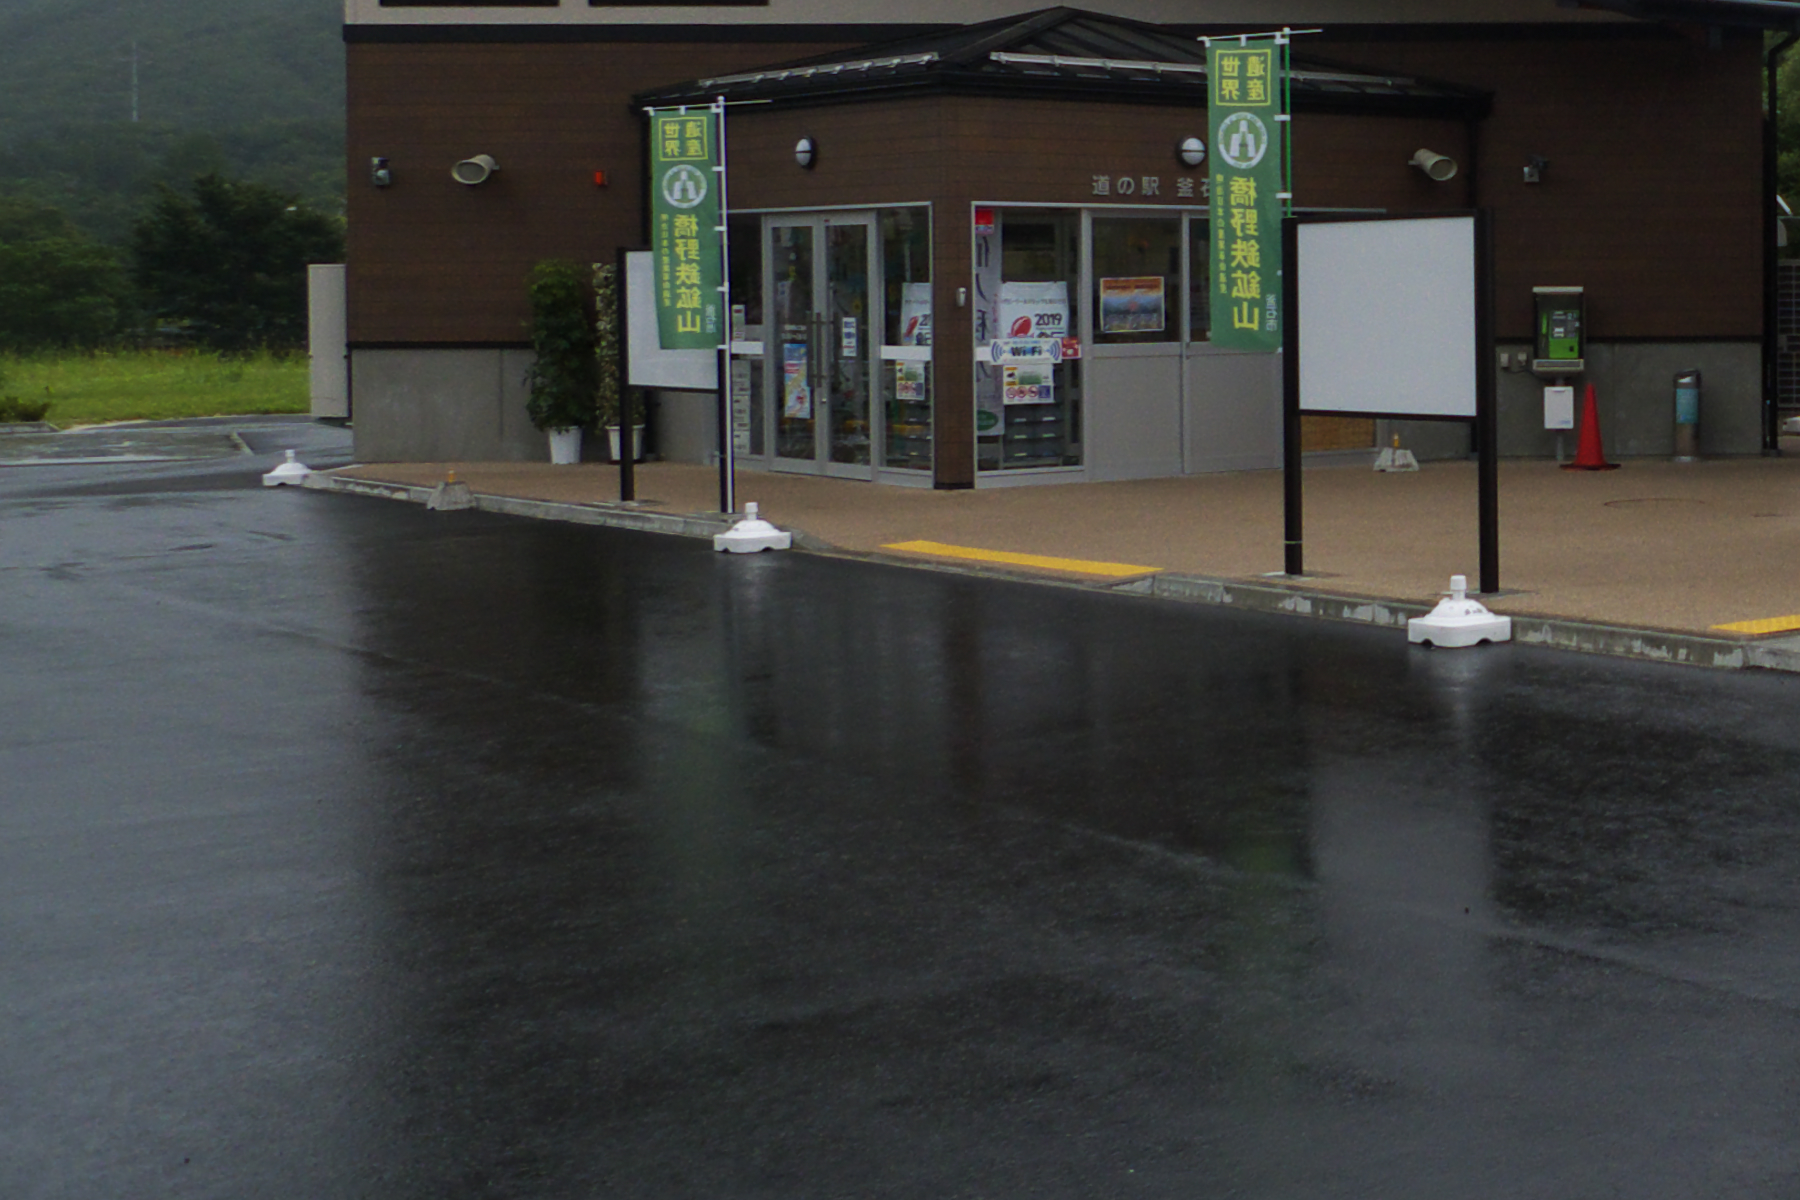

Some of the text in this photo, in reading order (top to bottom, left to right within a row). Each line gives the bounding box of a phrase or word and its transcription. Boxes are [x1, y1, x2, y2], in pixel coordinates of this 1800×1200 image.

[1091, 174, 1160, 196] 道の駅
[1034, 312, 1062, 326] 2019
